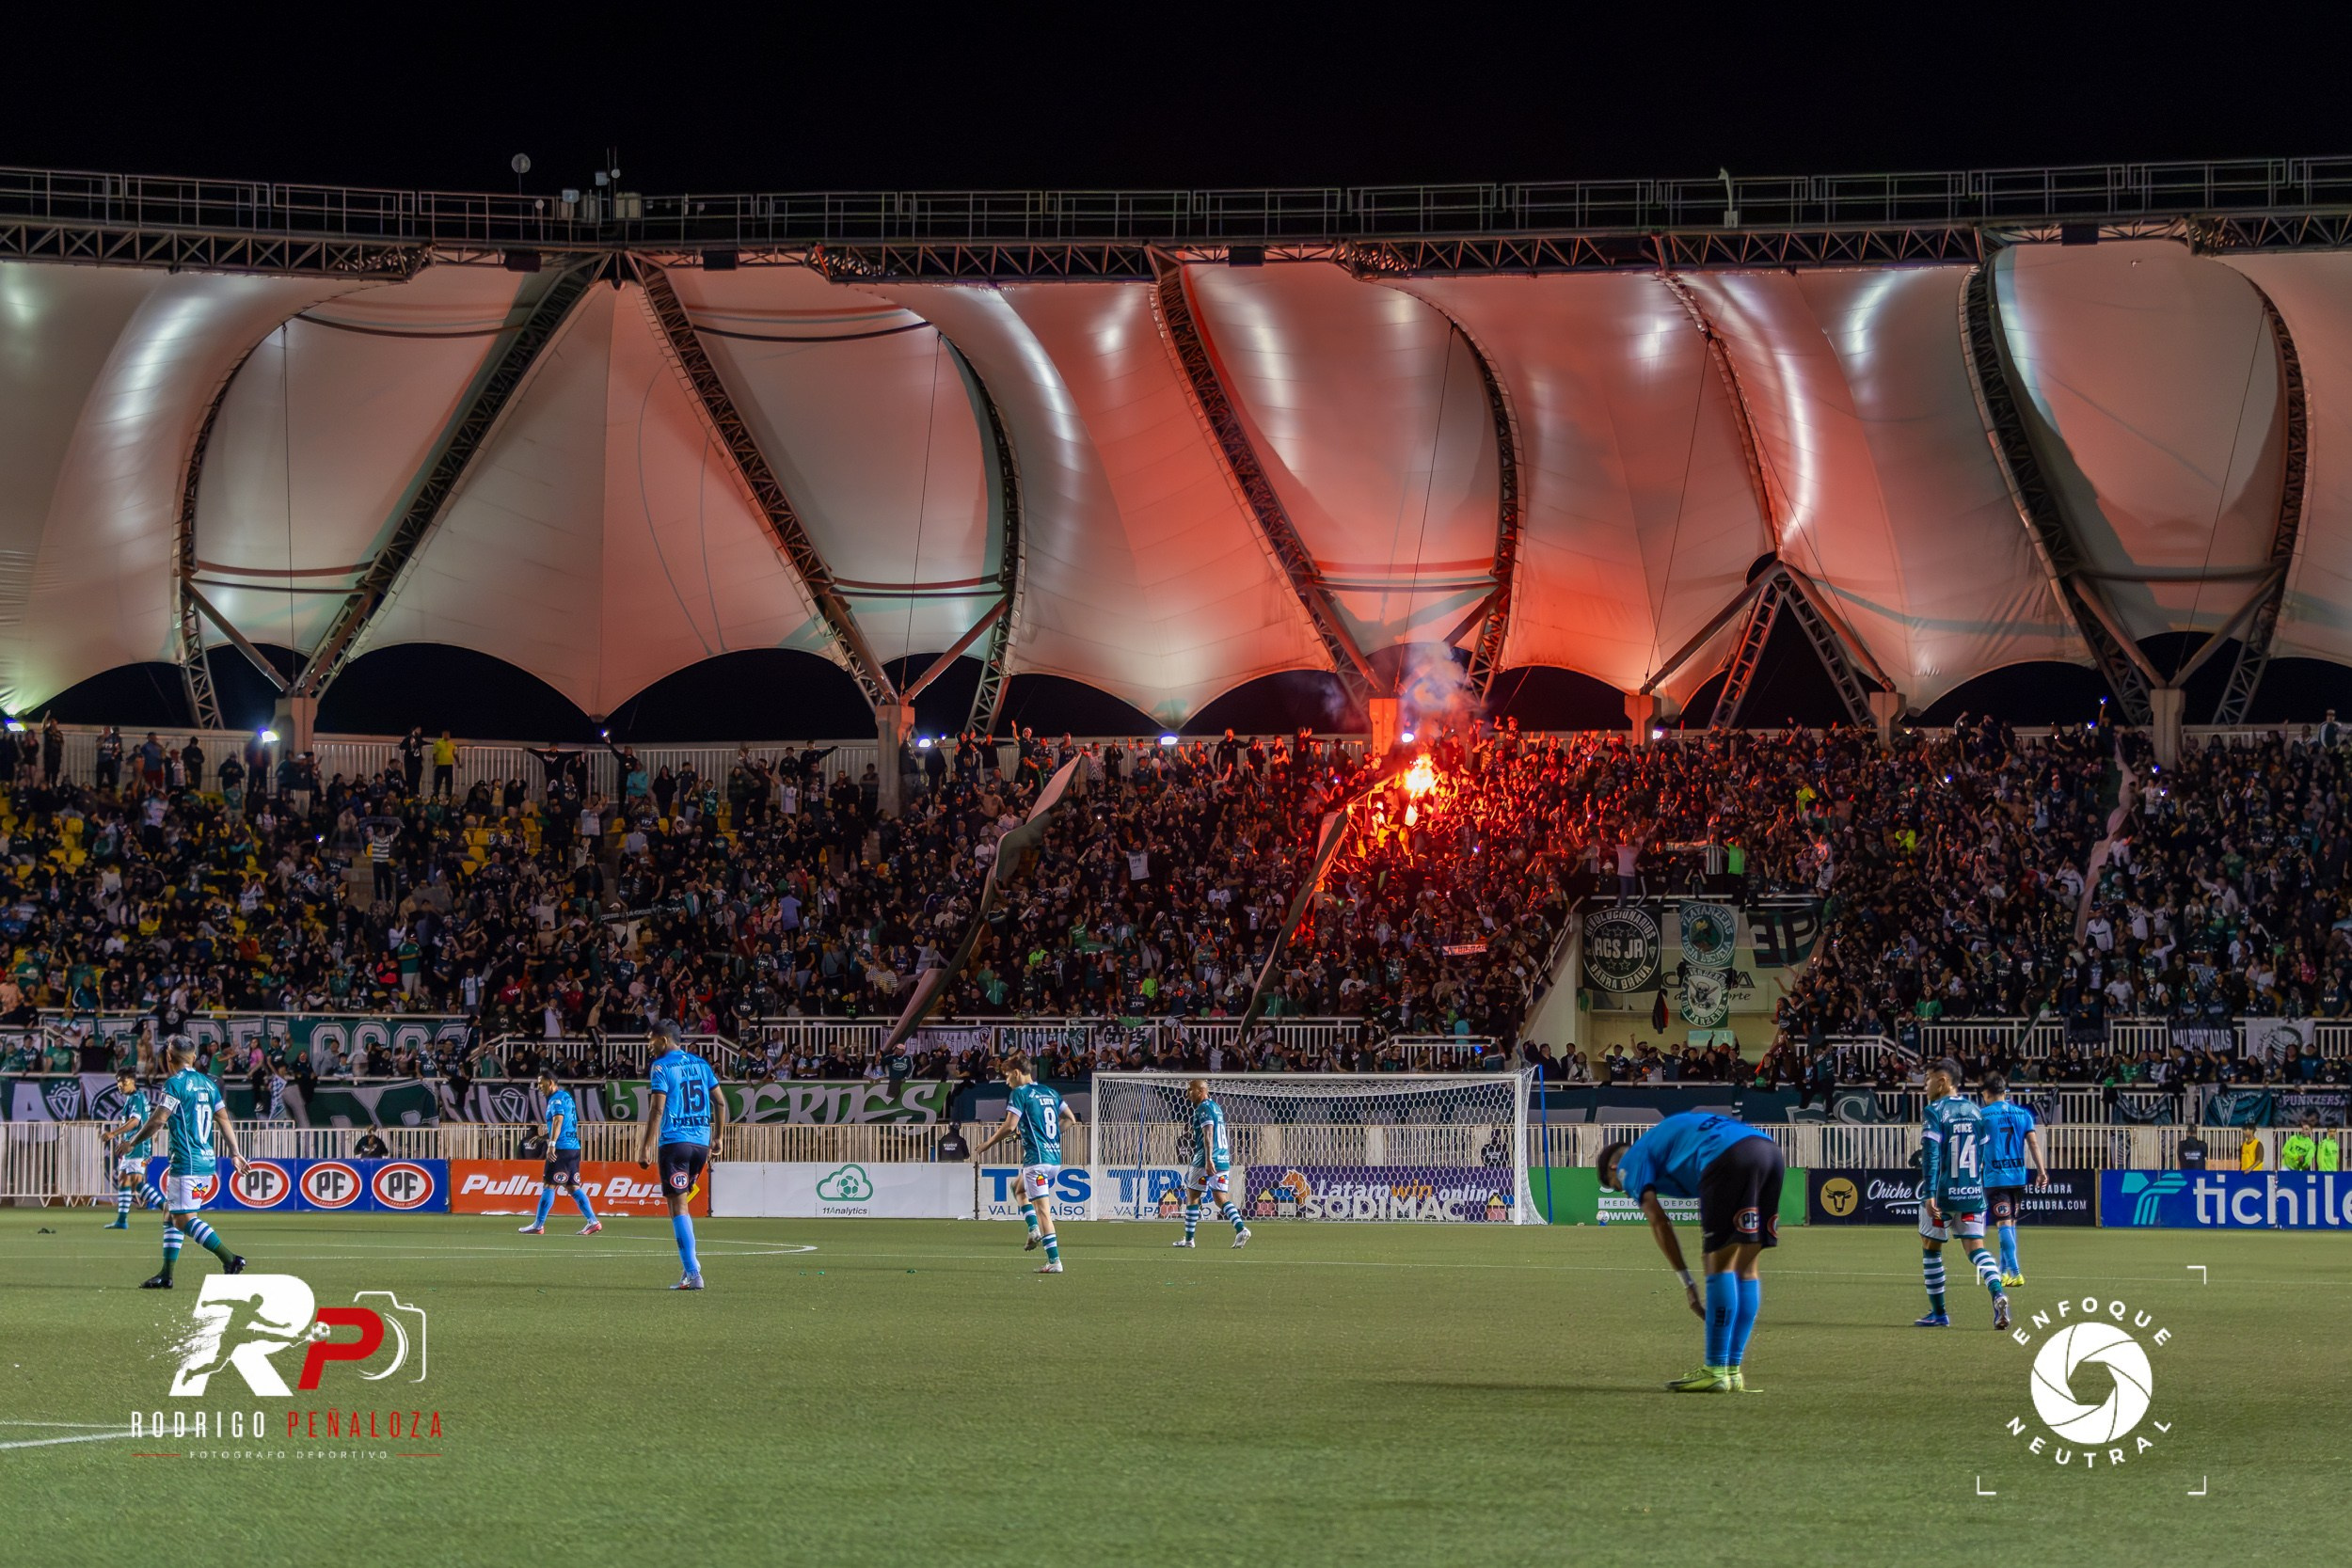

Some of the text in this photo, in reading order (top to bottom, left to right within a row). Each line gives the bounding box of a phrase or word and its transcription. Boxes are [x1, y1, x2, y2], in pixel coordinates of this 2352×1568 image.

[680, 1080, 706, 1115] 15
[196, 1104, 213, 1145] 10
[1043, 1106, 1057, 1140] 8
[1953, 1123, 1973, 1133] PONCE
[2000, 1126, 2014, 1155] 7
[1948, 1134, 1977, 1179] 14
[246, 1170, 275, 1199] PF
[316, 1171, 346, 1199] PF
[388, 1171, 418, 1200] PF
[981, 1168, 1091, 1203] TS
[1867, 1179, 1912, 1200] Chiche
[822, 1207, 868, 1216] 11Analytics
[1305, 1195, 1465, 1220] SODIMAC
[2020, 1199, 2088, 1211] ECUADRA.COM
